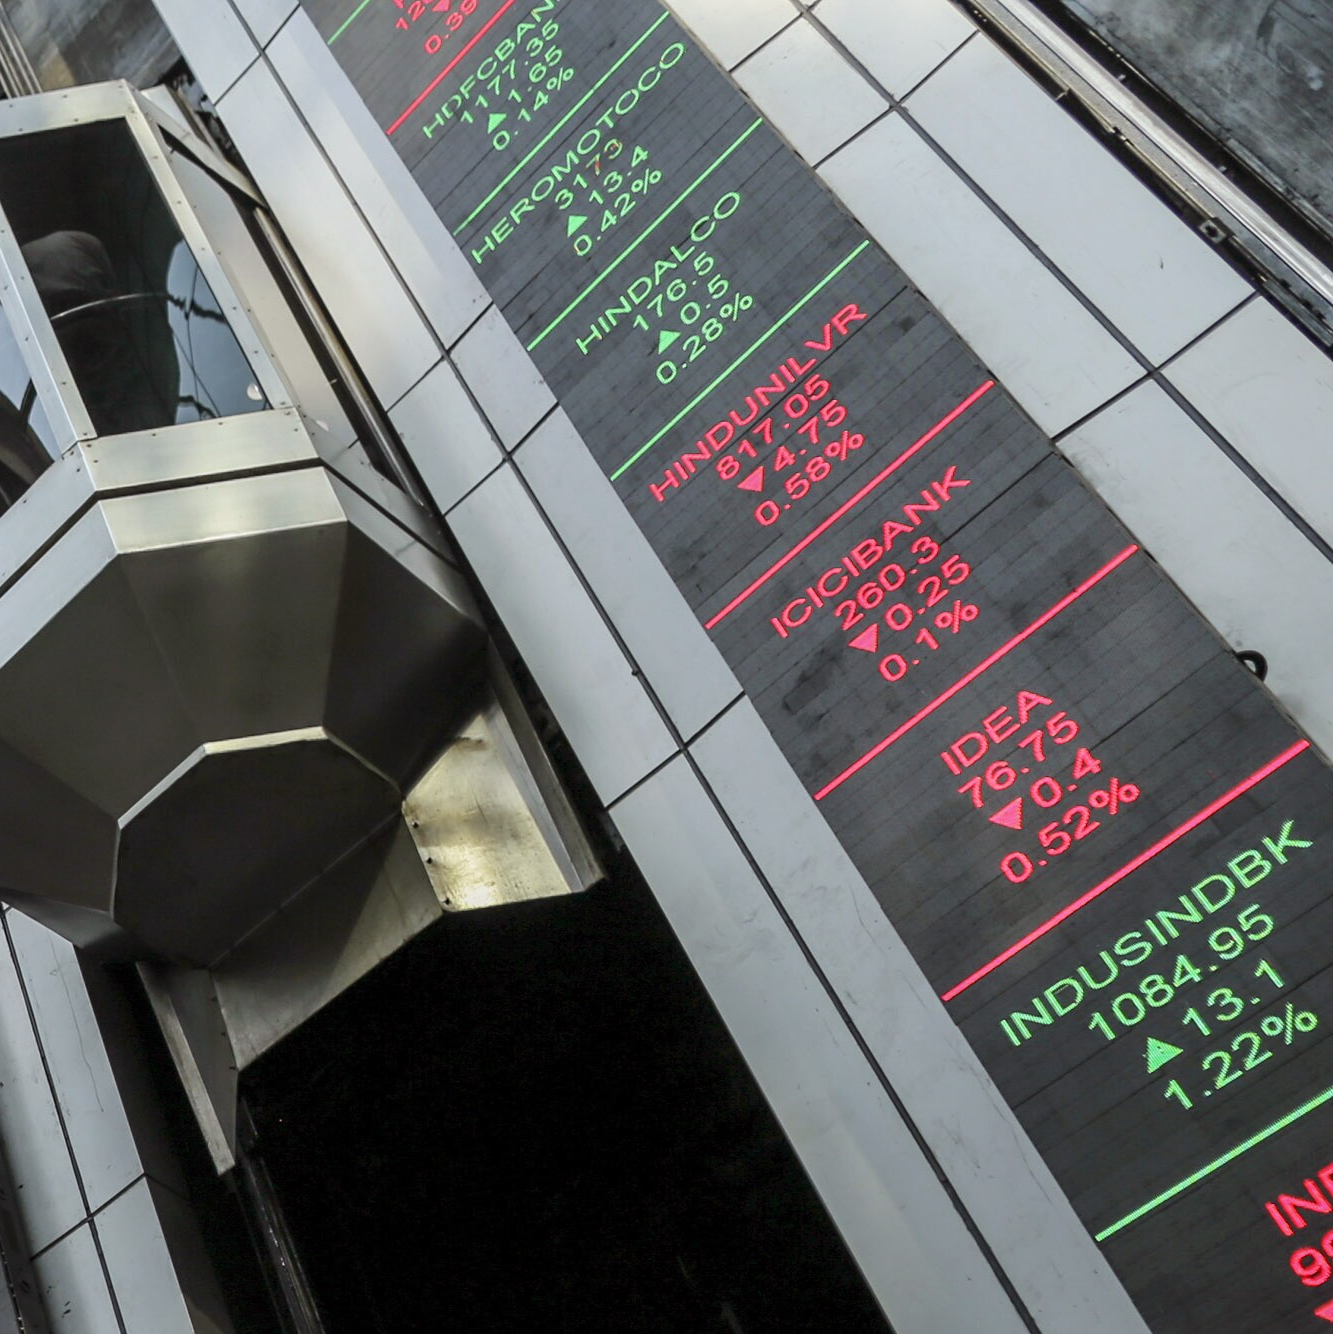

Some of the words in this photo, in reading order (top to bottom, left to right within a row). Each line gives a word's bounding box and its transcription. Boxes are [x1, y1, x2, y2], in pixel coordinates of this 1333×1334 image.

[422, 0, 561, 139] HDFCBAN
[460, 19, 559, 124] 1177.35
[492, 68, 574, 150] 0.14%
[508, 45, 563, 103] 1.65
[471, 42, 685, 264] HEROMOTOCO
[554, 138, 624, 210] 3173
[589, 145, 650, 205] 13.4
[573, 169, 662, 257] 0.42%
[575, 191, 741, 355] HINDALCO
[633, 251, 715, 331] 176.5
[679, 274, 730, 325] 0.5
[655, 294, 754, 385] 0.28%
[715, 374, 831, 481] 817.05
[773, 400, 847, 472] 4.75
[754, 430, 865, 527] 0.58%
[770, 465, 972, 639] ICICIBANK
[834, 536, 940, 631] 260.3
[885, 554, 972, 632] 0.25
[878, 599, 979, 683] 0.1%
[941, 690, 1053, 776] IDEA
[958, 712, 1079, 808] 76.75
[1031, 748, 1102, 808] 0.4
[1000, 777, 1140, 885] 0.52%
[999, 819, 1313, 1047] INDUSINDBK
[1088, 904, 1275, 1042] 1084.95
[1182, 959, 1286, 1036] 13.1
[1163, 1002, 1319, 1111] 1.22%
